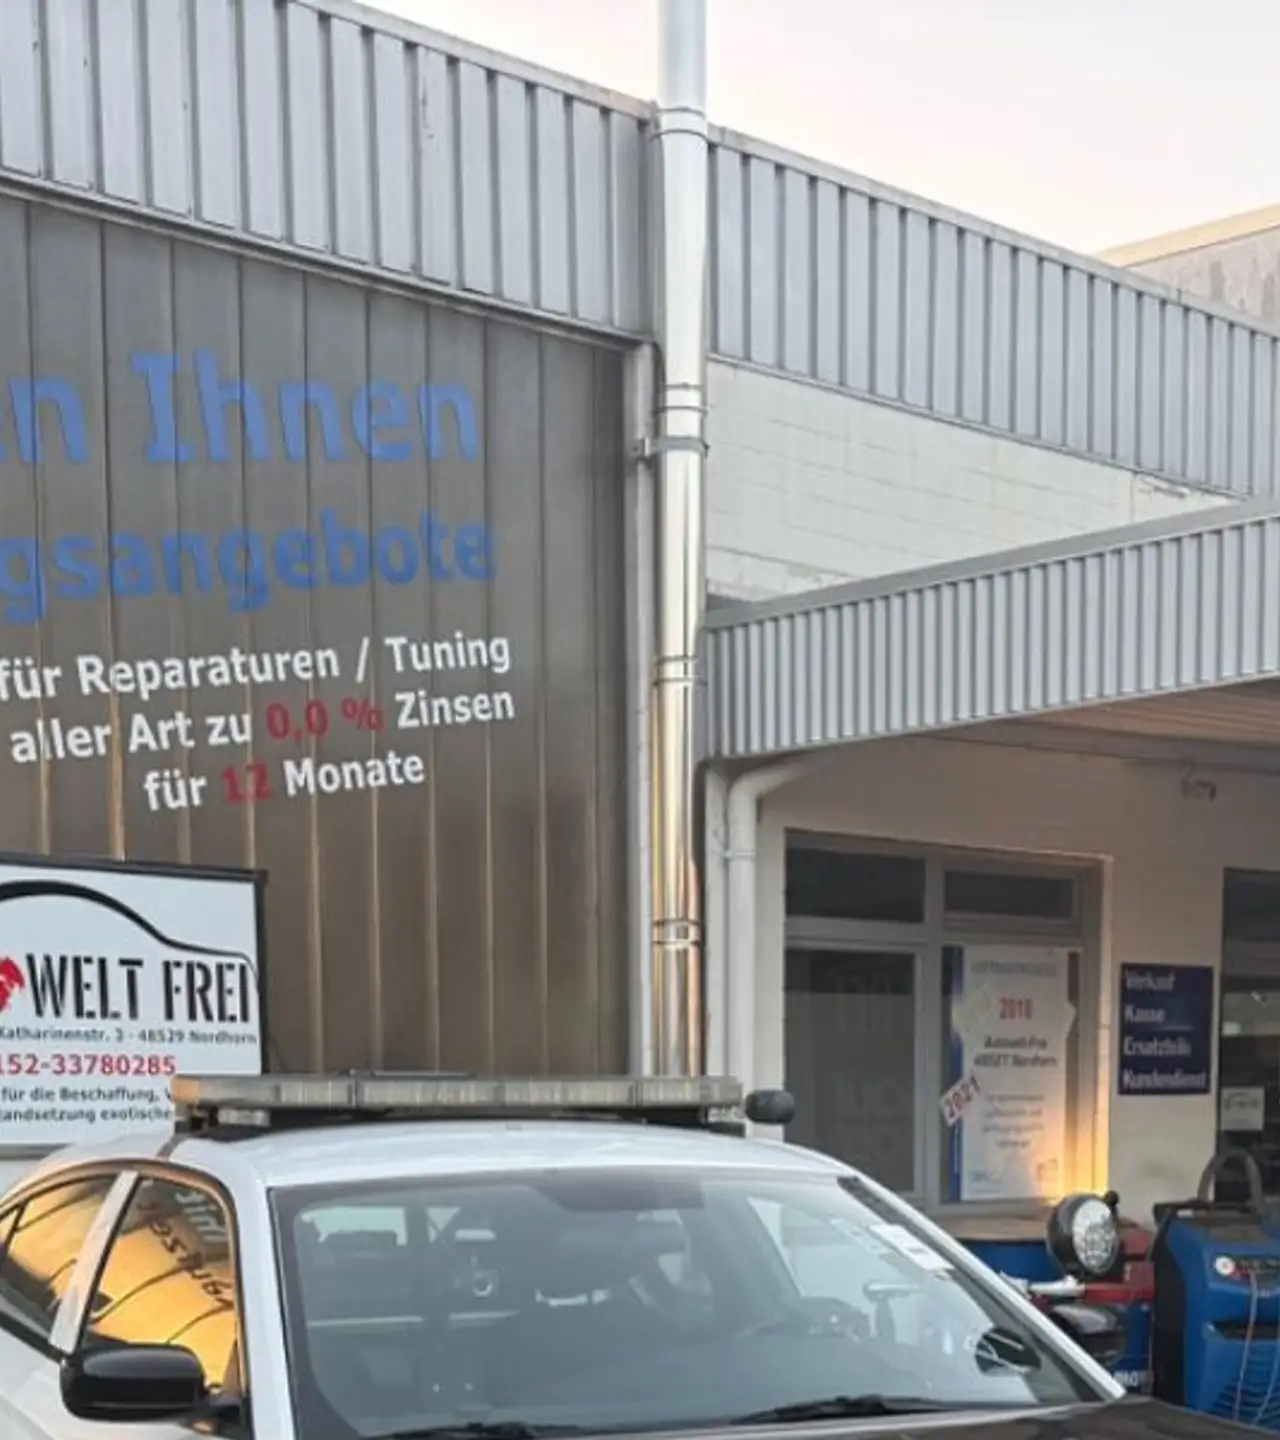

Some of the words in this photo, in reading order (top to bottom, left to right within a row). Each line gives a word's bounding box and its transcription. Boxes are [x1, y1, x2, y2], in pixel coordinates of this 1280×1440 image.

[130, 346, 482, 464] Ihnen
[77, 646, 340, 699] Reparaturen
[385, 631, 510, 674] Tuning
[11, 718, 112, 763] aller
[128, 711, 195, 752] Art
[207, 712, 251, 744] zu
[267, 701, 329, 745] 0,0
[341, 698, 384, 731] %
[394, 690, 515, 729] Zinsen
[145, 769, 208, 811] für
[223, 764, 273, 804] 12
[283, 751, 426, 797] Monate
[161, 959, 251, 1024] FREI
[1, 1087, 25, 1101] für
[29, 1087, 55, 1101] die
